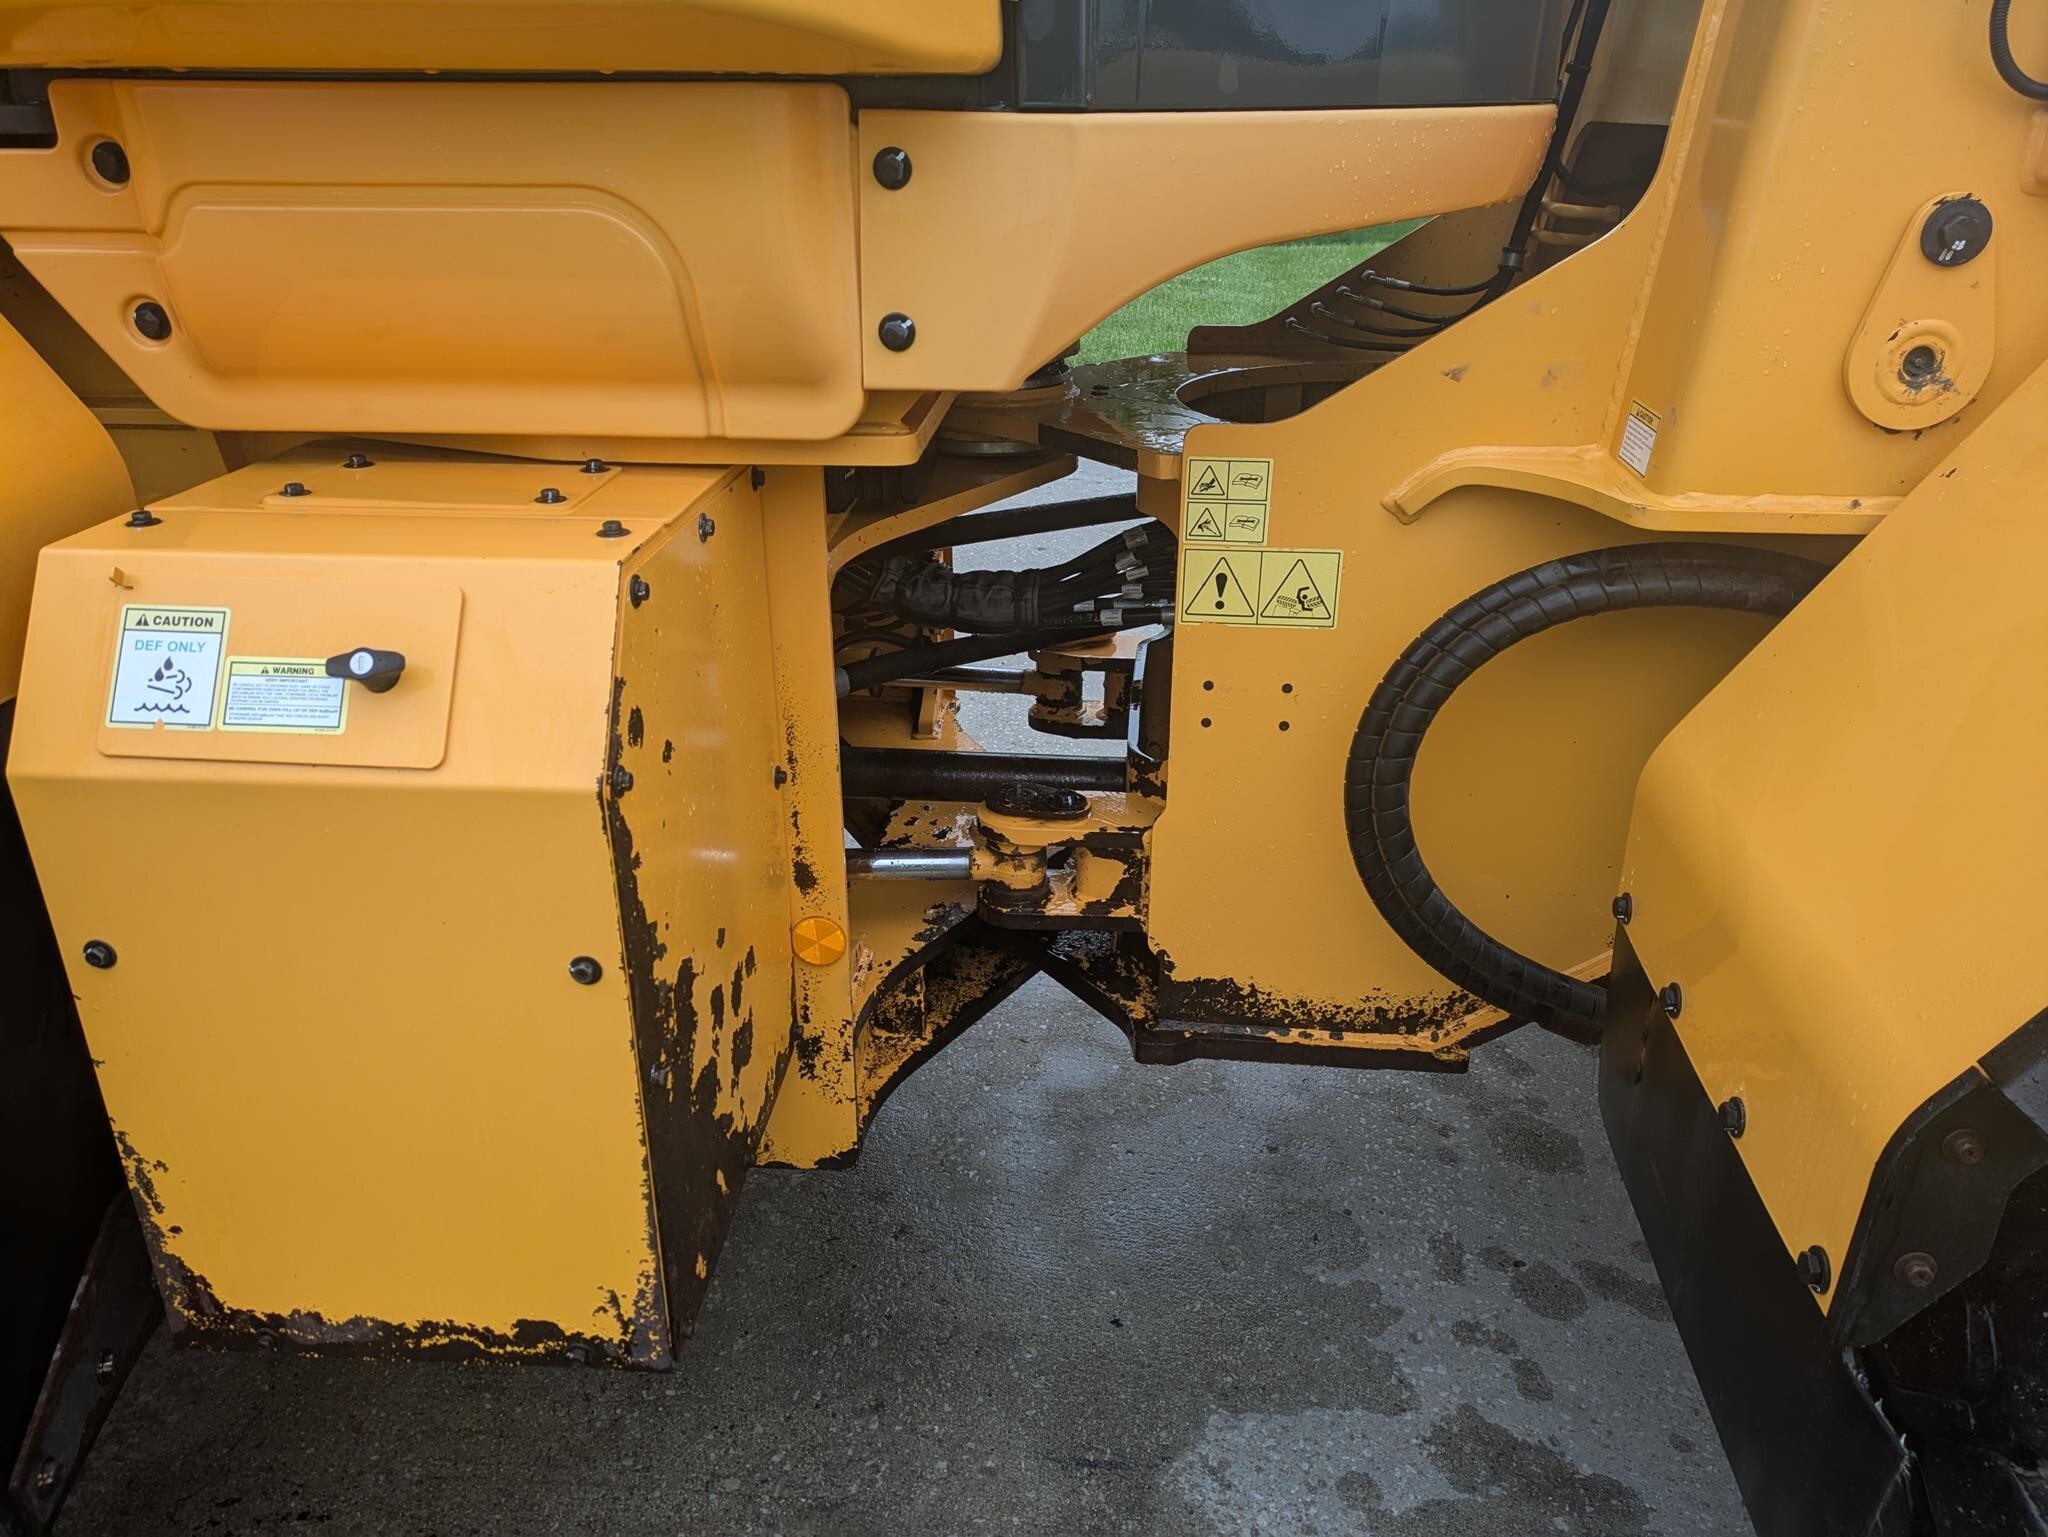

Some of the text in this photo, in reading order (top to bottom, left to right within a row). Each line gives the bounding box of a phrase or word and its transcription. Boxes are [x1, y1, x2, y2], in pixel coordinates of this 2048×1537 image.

[153, 616, 214, 628] CAUTION
[134, 639, 206, 653] DEF ONLY
[272, 666, 315, 675] WARNING
